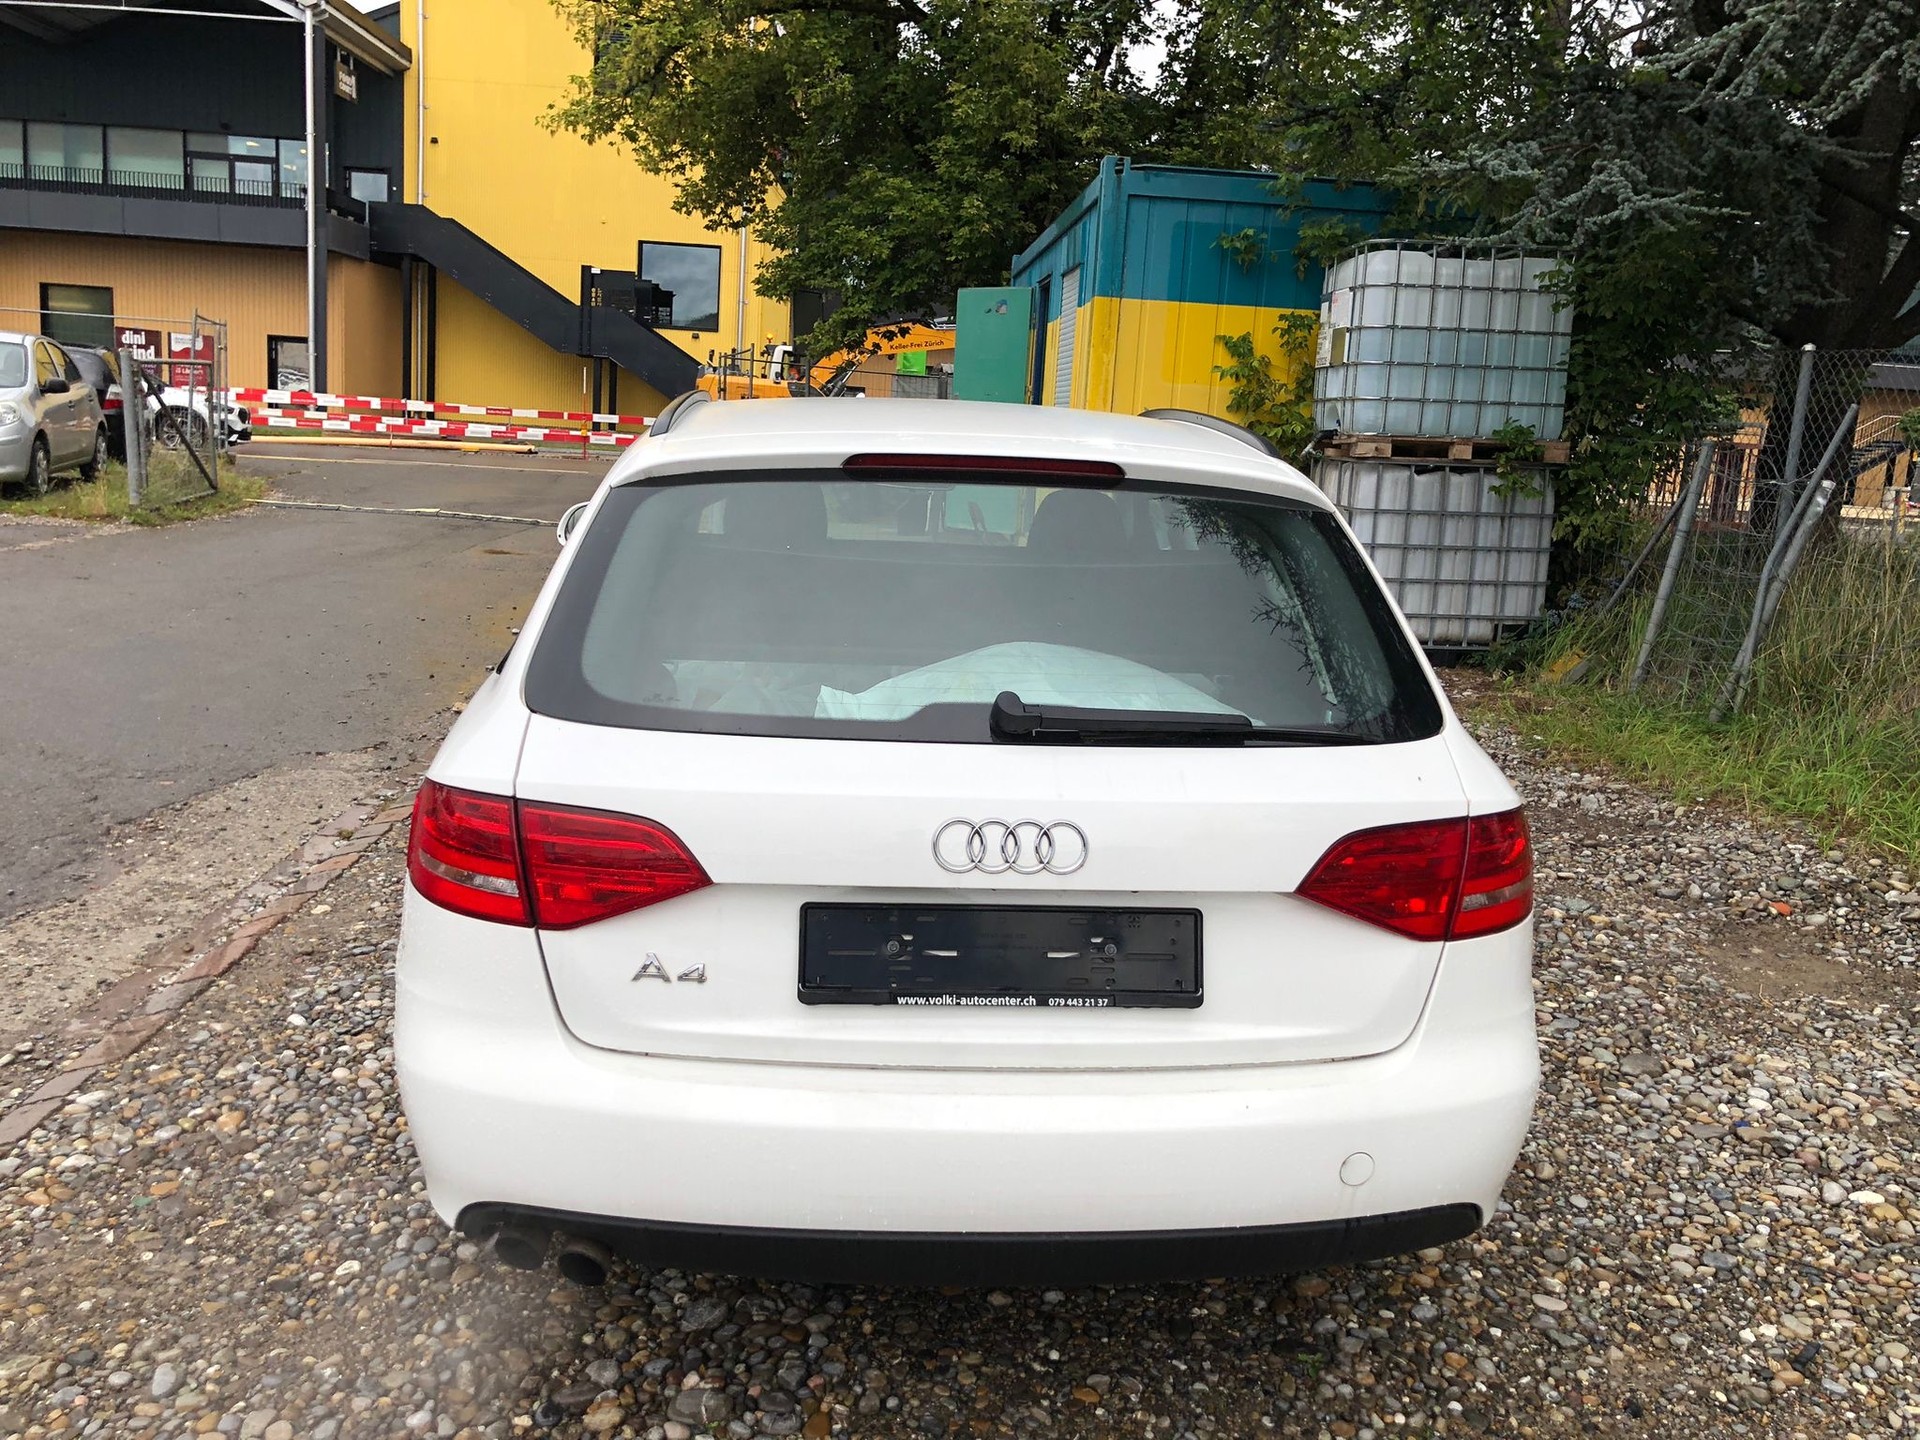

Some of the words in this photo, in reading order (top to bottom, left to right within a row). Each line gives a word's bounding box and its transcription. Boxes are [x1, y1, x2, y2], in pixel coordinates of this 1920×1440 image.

[121, 330, 146, 344] dini
[897, 994, 1037, 1006] www.volki-autocenter.ch
[1048, 997, 1065, 1007] 079
[1066, 997, 1083, 1007] 443
[1084, 998, 1095, 1007] 21
[1097, 998, 1109, 1007] 37
